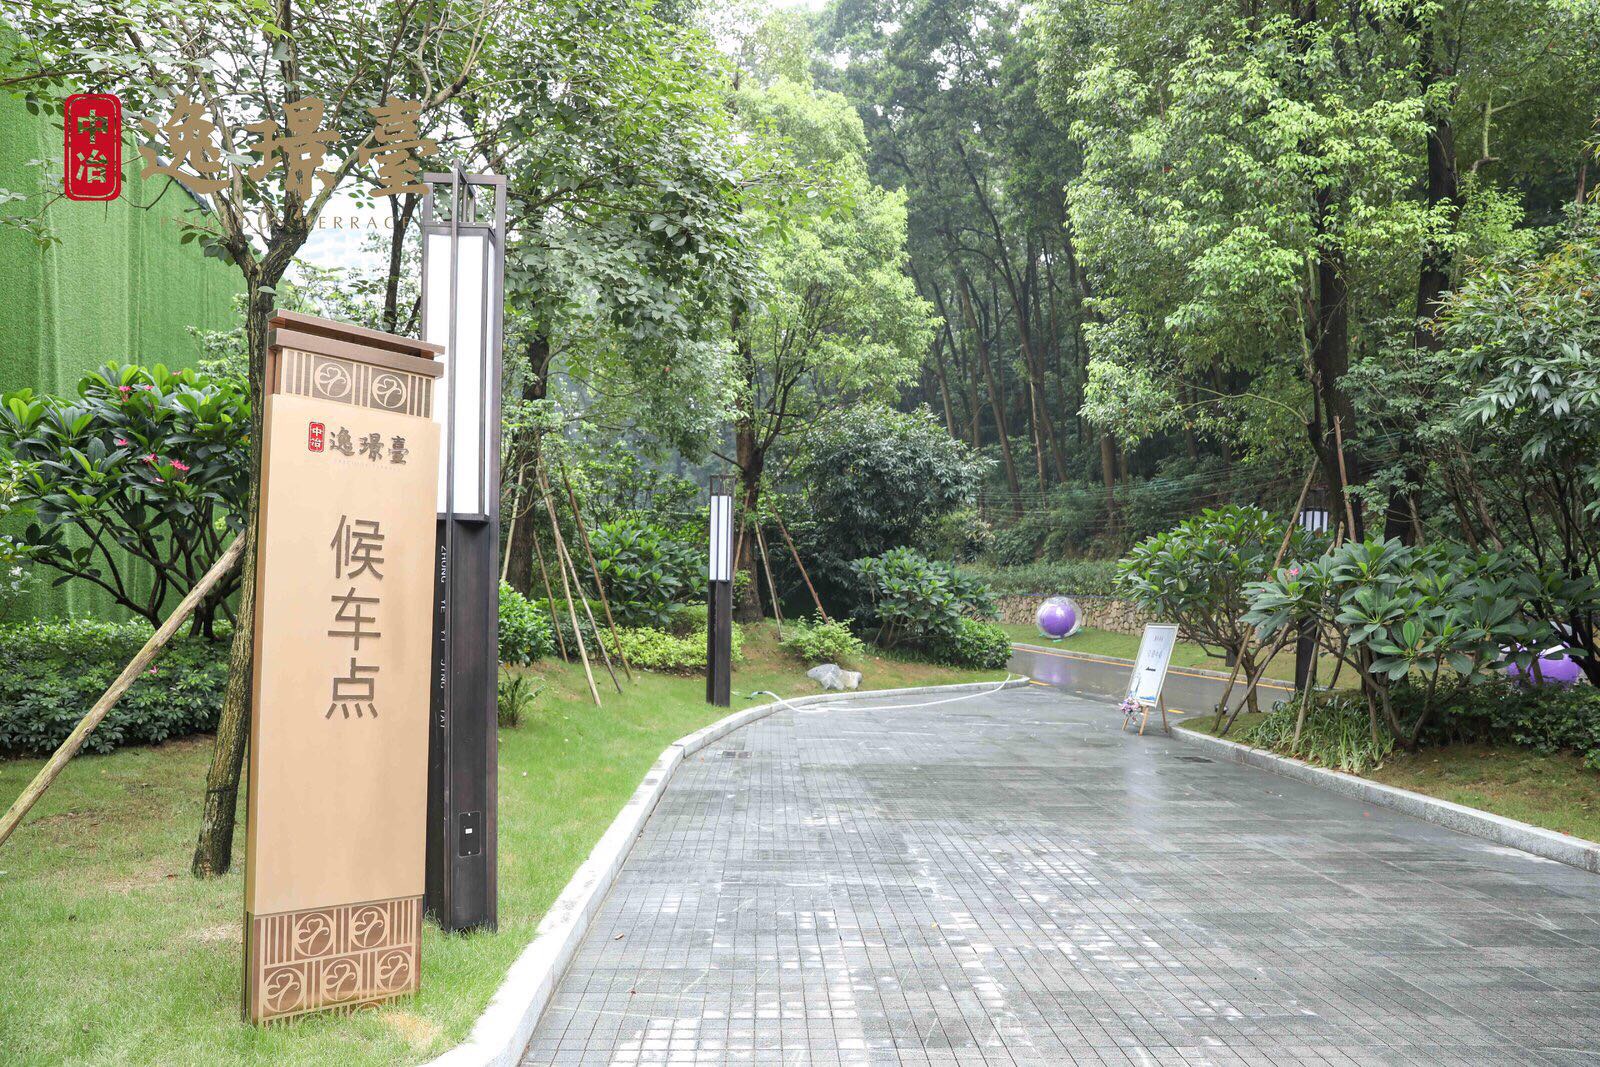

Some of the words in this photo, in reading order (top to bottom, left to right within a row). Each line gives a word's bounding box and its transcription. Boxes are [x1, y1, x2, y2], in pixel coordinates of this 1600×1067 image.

[310, 426, 324, 449] 中冶
[325, 515, 385, 720] 候车点
